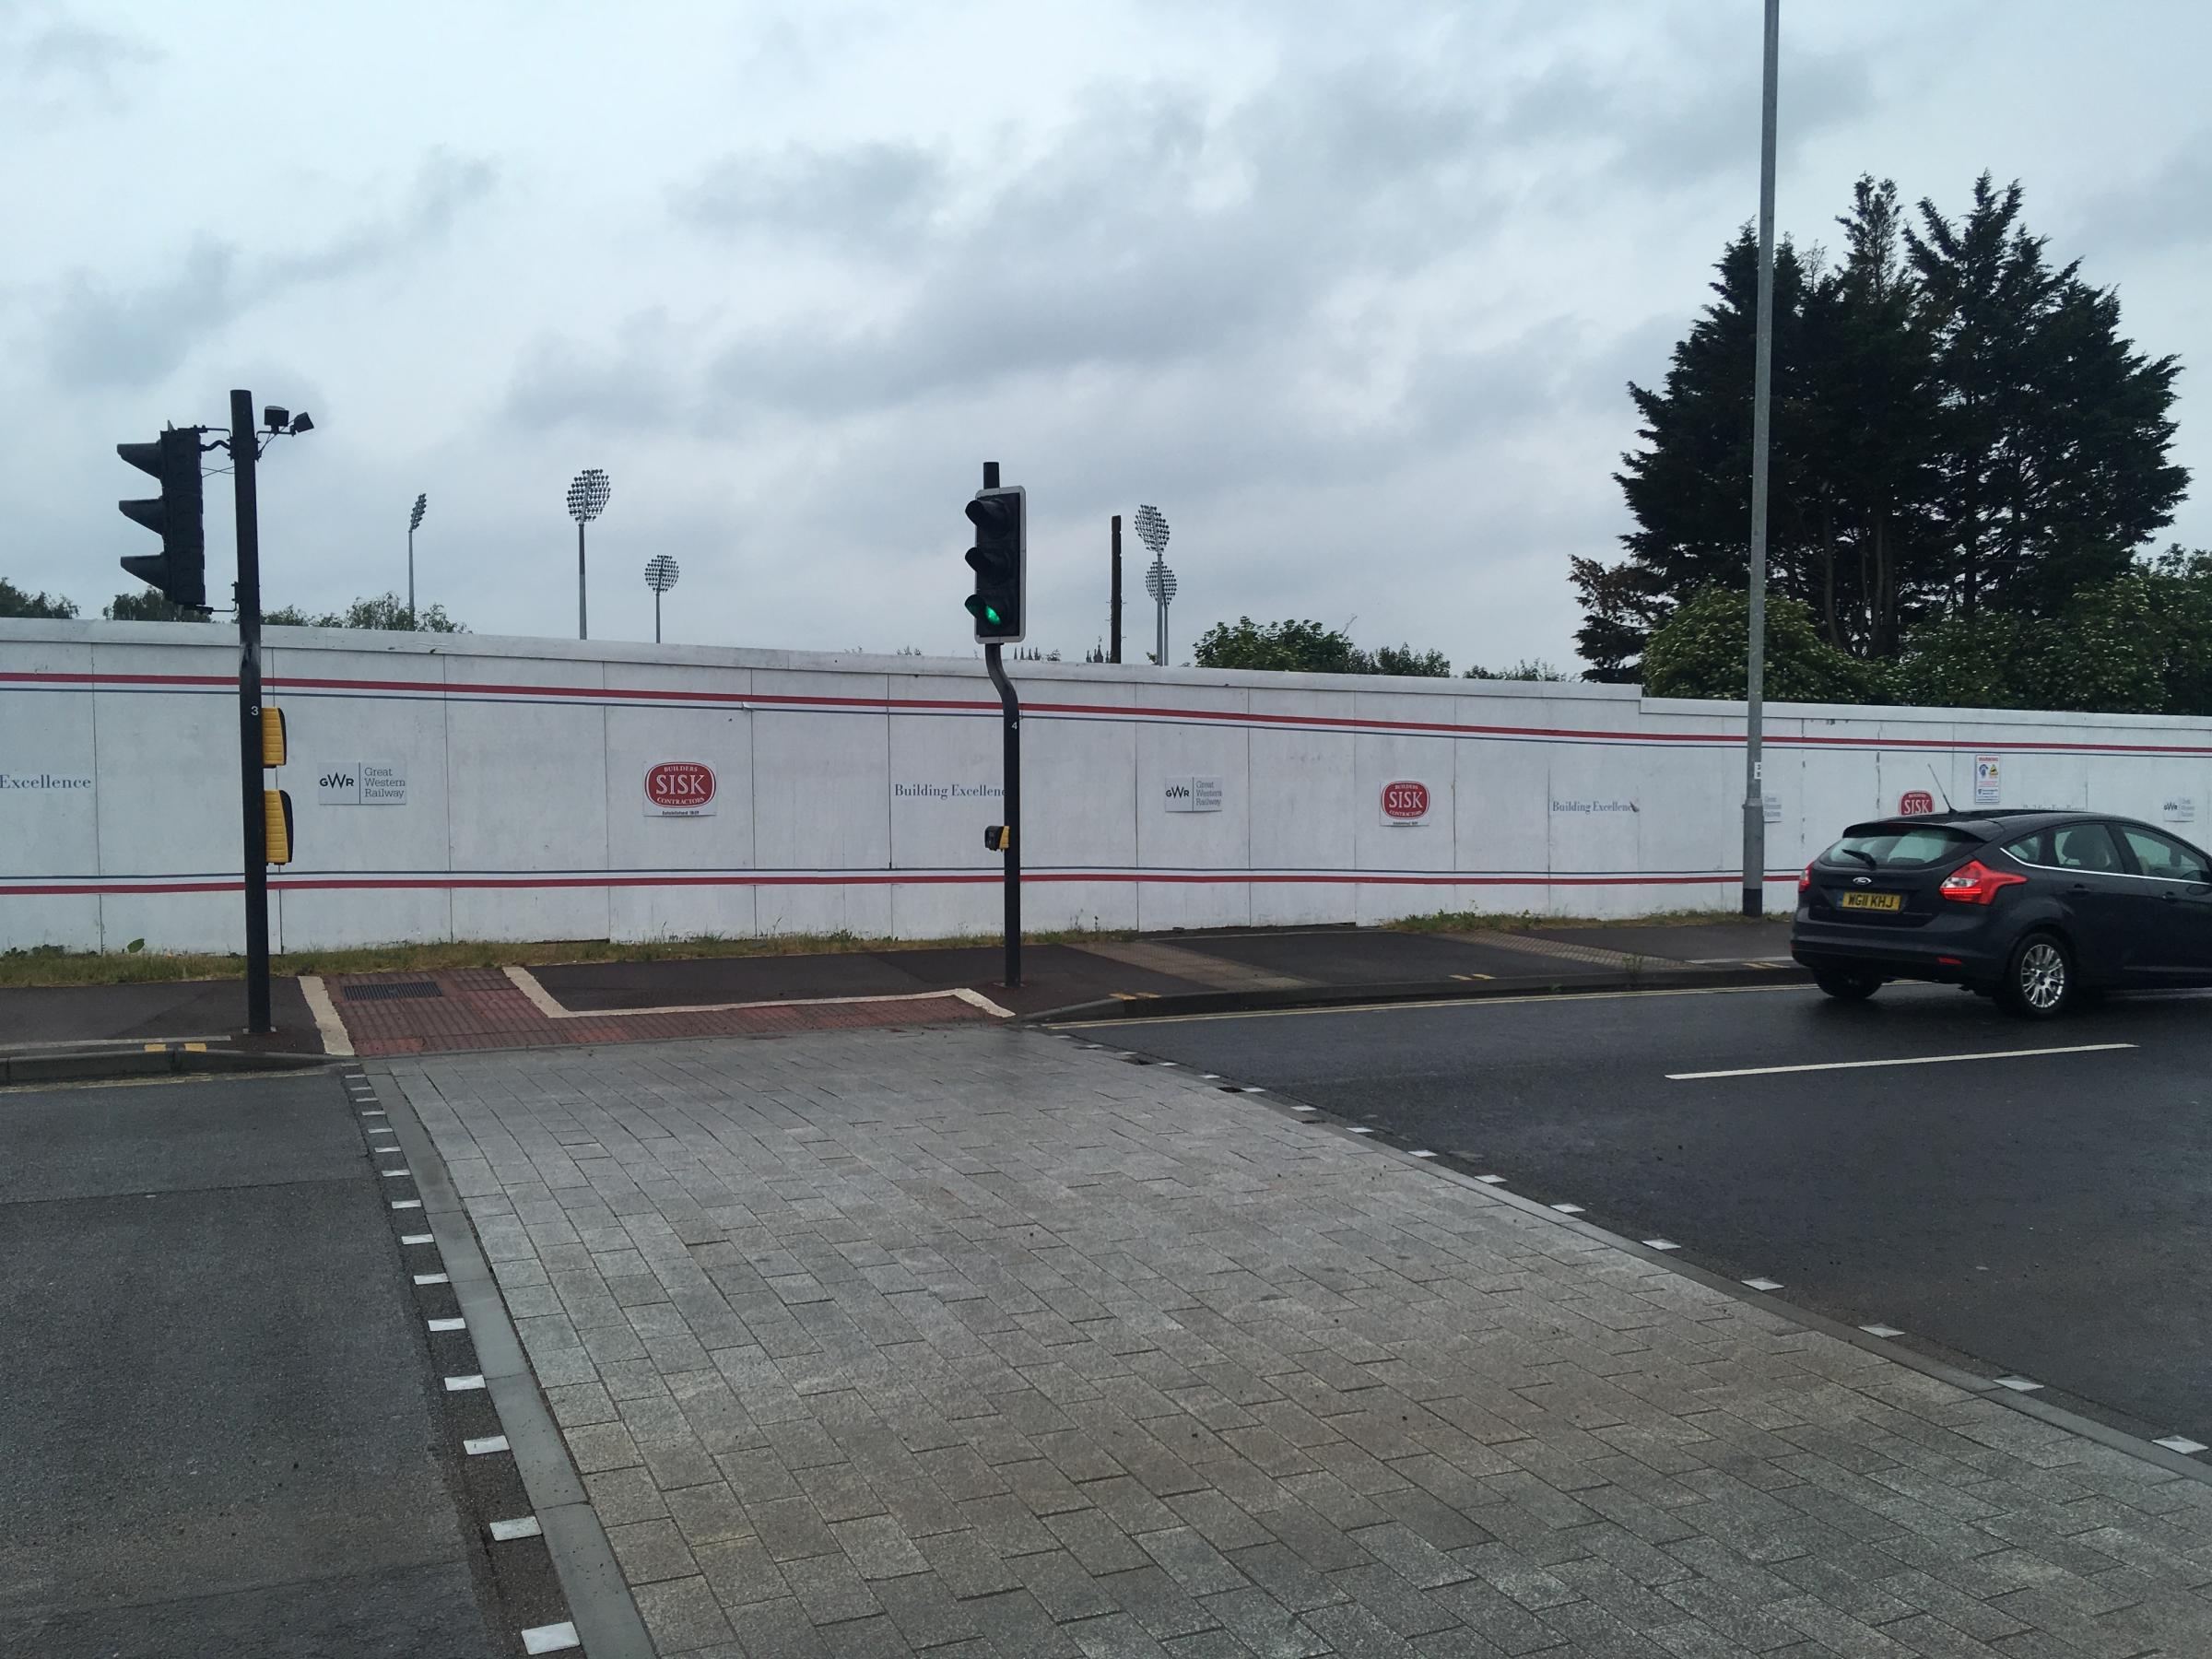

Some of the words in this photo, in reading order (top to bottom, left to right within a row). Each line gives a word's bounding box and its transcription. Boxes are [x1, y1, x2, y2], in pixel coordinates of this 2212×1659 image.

[251, 705, 259, 716] 3
[1011, 722, 1018, 730] 4
[364, 767, 393, 777] Great
[0, 773, 91, 789] Excellence
[319, 771, 355, 789] GWR
[364, 777, 406, 787] Western
[655, 774, 706, 794] SISK
[364, 788, 405, 799] Railway
[894, 783, 948, 800] Building
[951, 783, 1006, 796] Excellenc
[1165, 784, 1190, 799] GWR
[656, 796, 705, 805] CONTRACTORS
[1388, 791, 1423, 808] SISK
[1903, 799, 1930, 815] SISK
[1552, 800, 1591, 816] Building
[1593, 800, 1633, 812] Excellenc
[1870, 895, 1895, 909] KHJ
